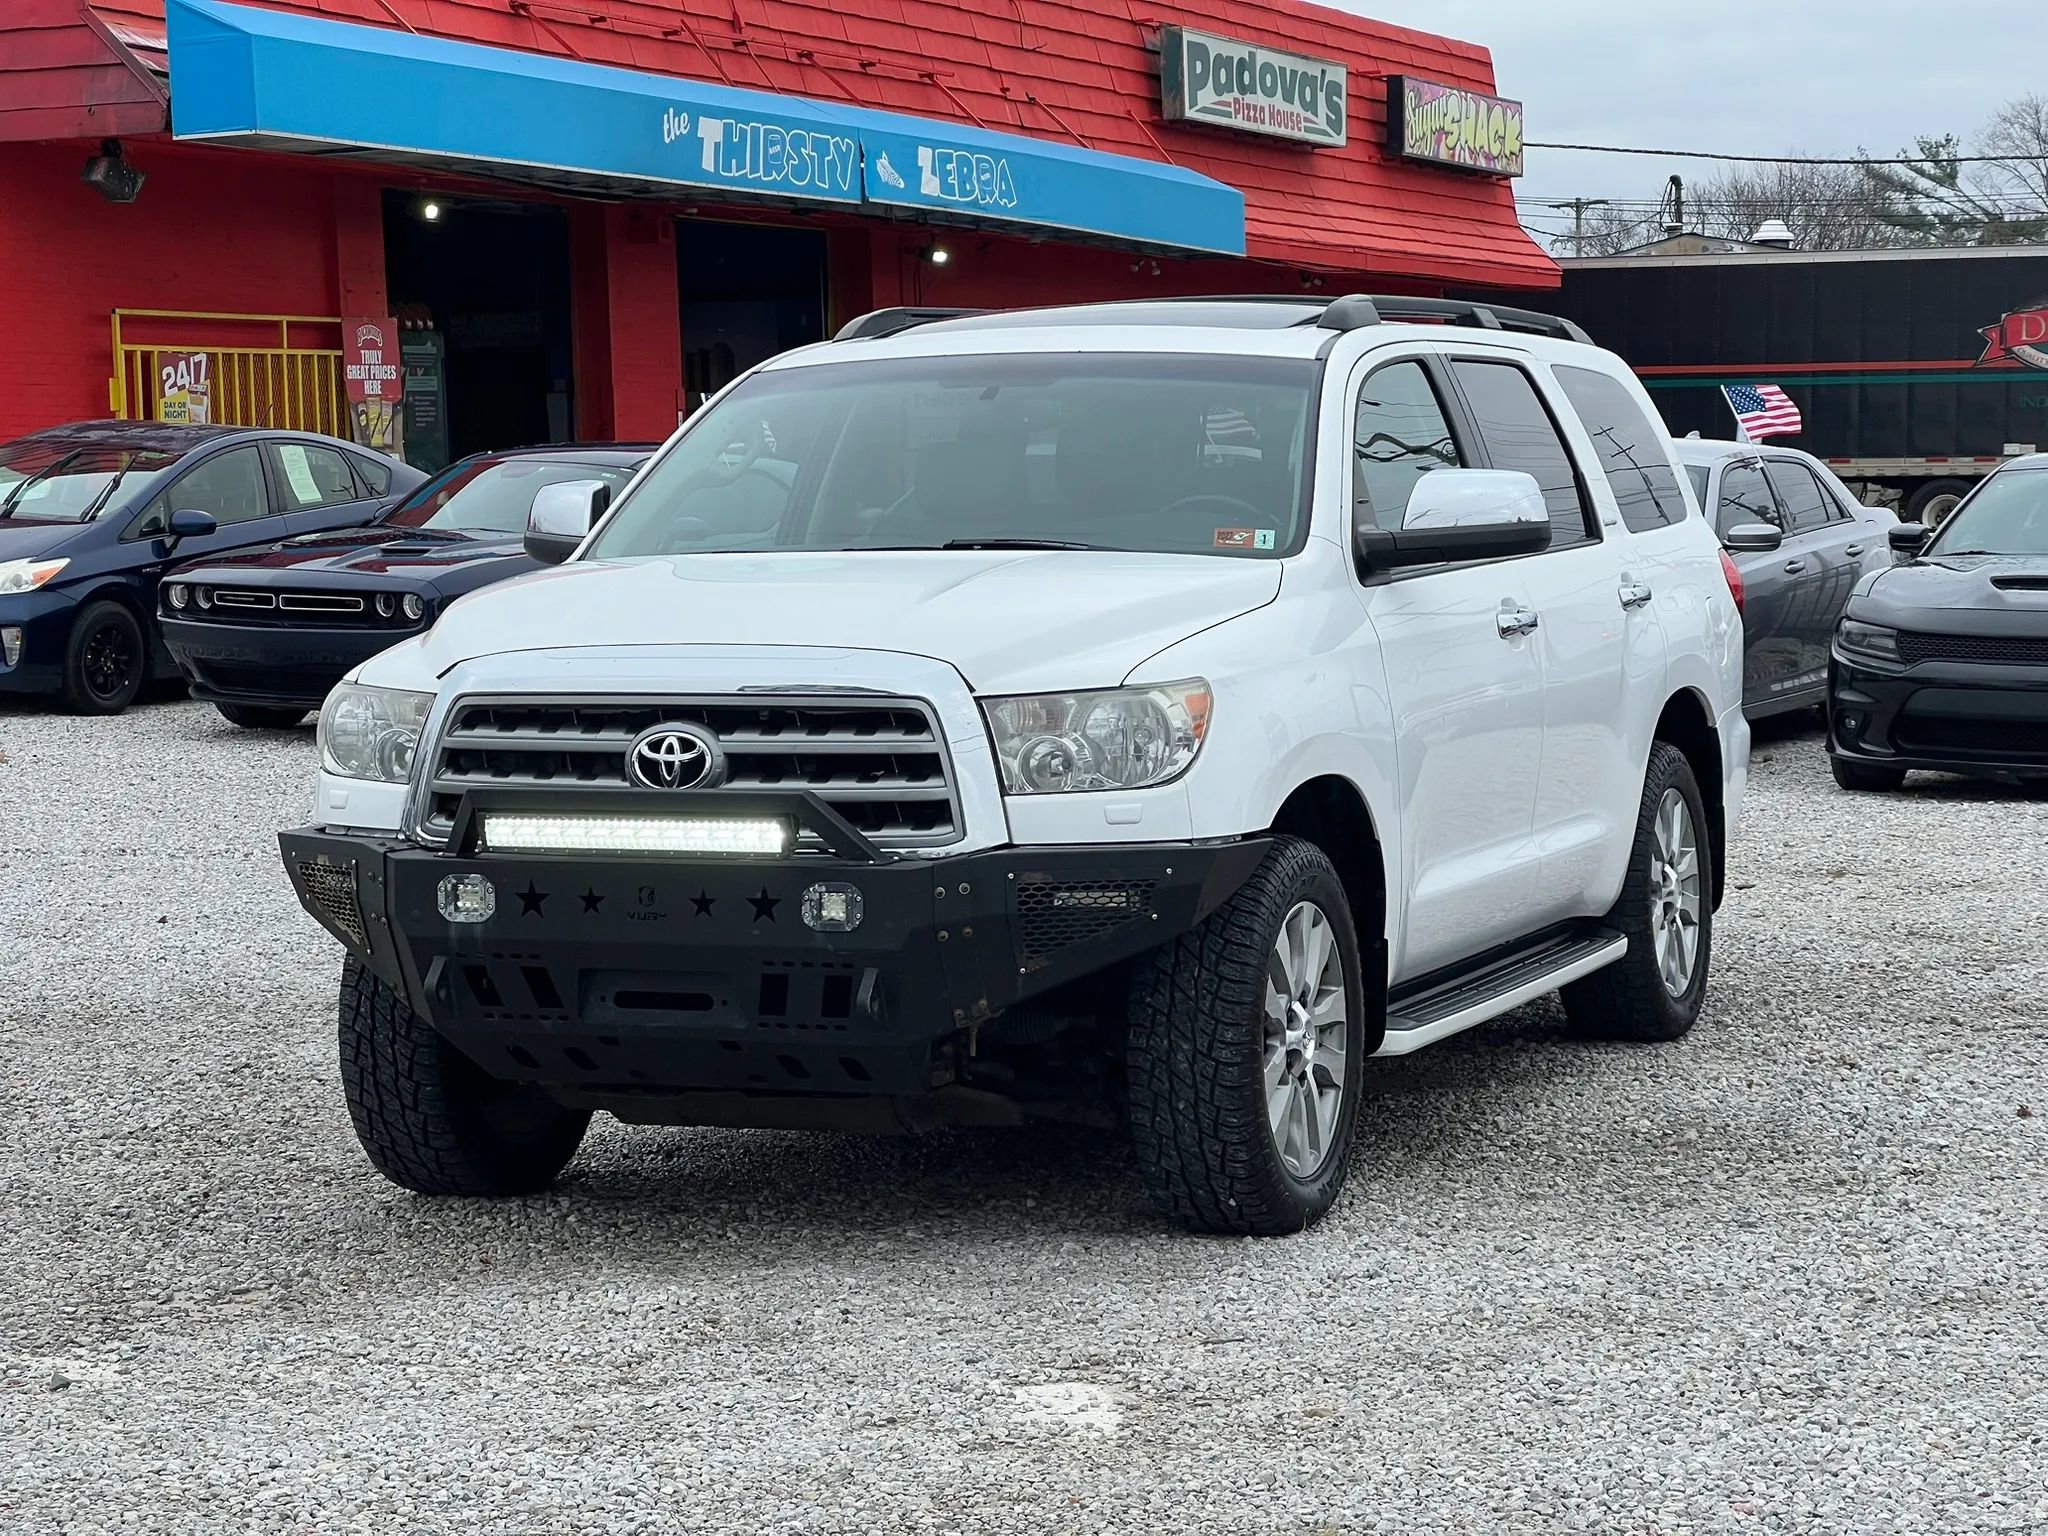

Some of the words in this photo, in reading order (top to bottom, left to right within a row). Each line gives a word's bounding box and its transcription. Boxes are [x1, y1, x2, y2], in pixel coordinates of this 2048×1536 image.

[1186, 39, 1344, 138] Padova's
[1233, 97, 1266, 126] Pizza
[1268, 104, 1303, 133] House
[1444, 92, 1522, 161] SHACK
[663, 107, 691, 144] the
[697, 116, 855, 191] THIRSTY
[917, 146, 1018, 208] ZEBRA
[360, 349, 382, 365] TRULY
[162, 353, 207, 397] 24/7
[346, 364, 369, 380] GREAT
[370, 365, 397, 380] PRICES
[364, 380, 382, 395] HERE
[164, 401, 176, 409] DAY
[177, 401, 187, 409] OR
[164, 410, 187, 419] NIGHT
